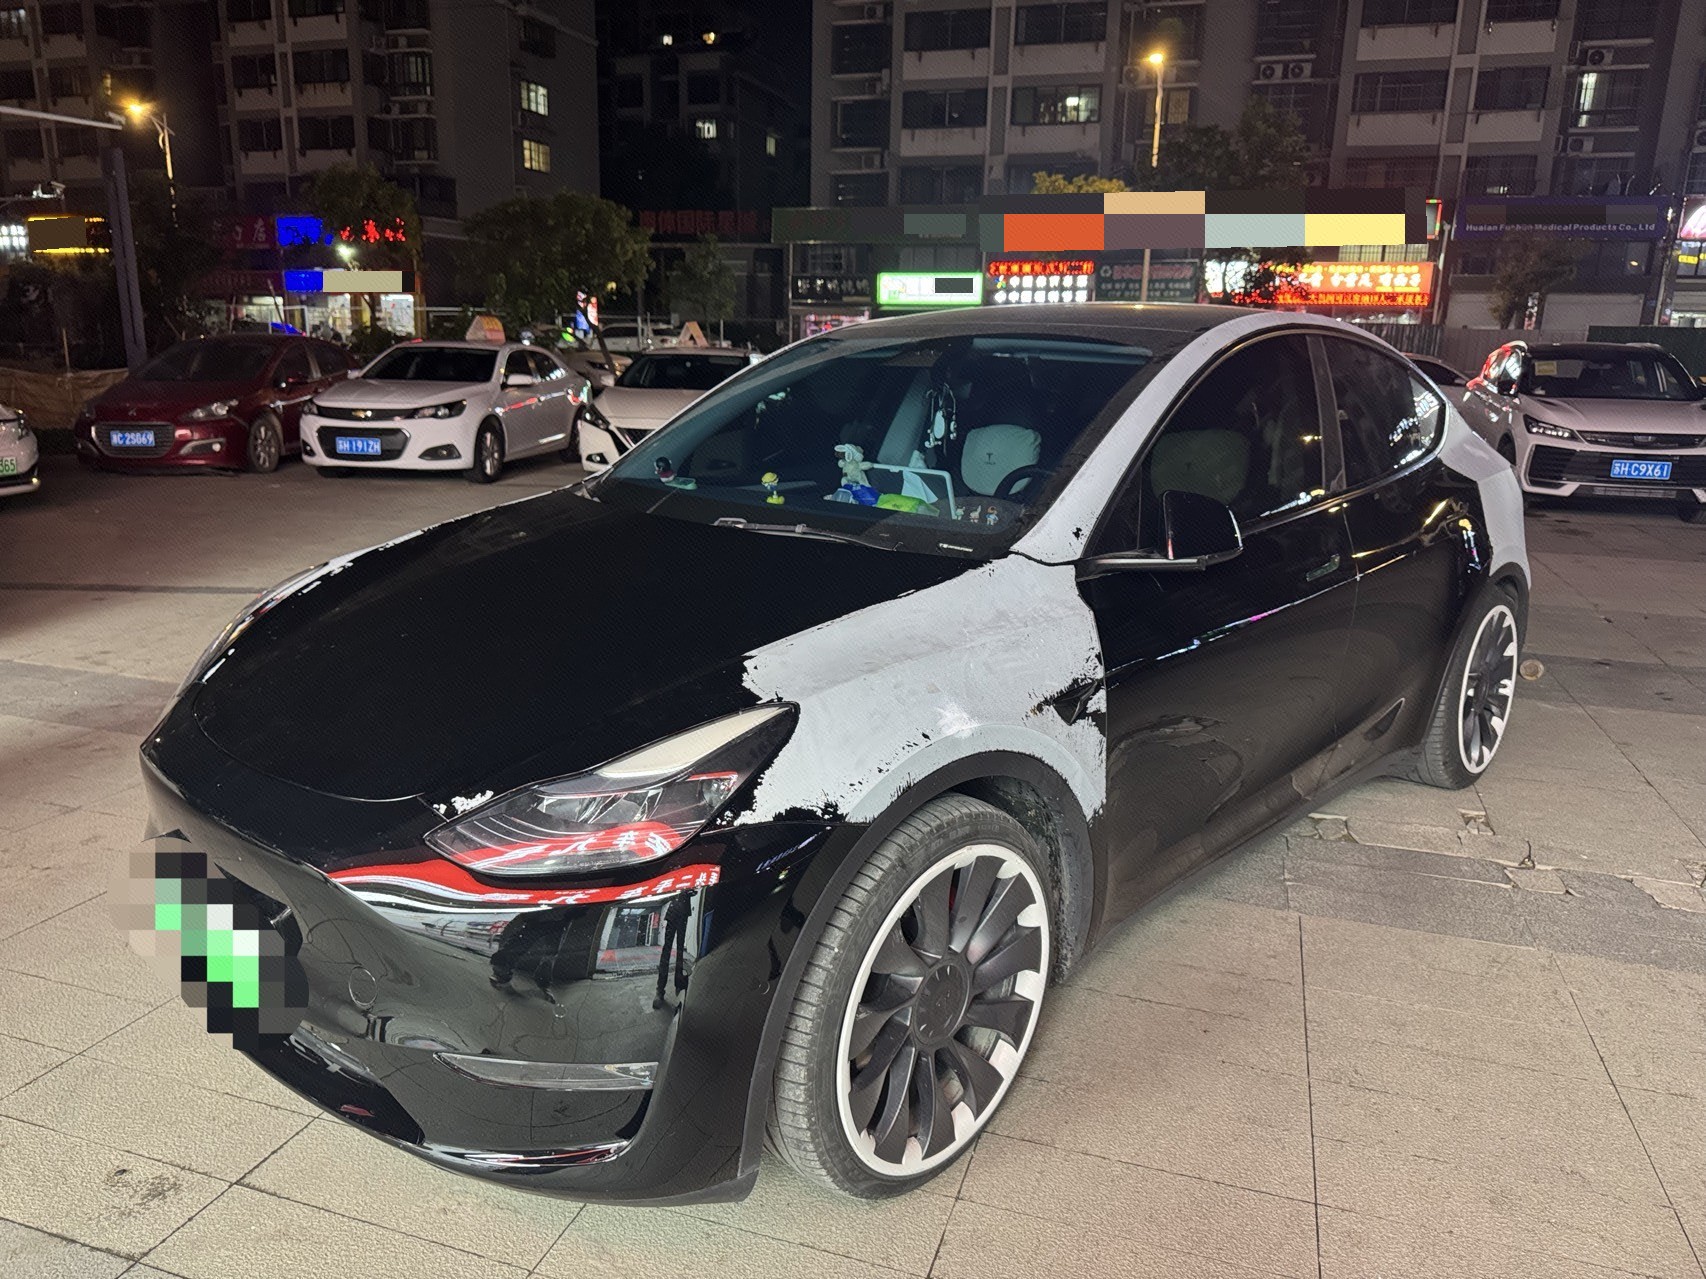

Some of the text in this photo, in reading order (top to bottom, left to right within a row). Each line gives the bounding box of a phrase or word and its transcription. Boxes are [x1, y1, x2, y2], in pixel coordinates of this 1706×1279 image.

[1534, 223, 1572, 232] Medical
[1573, 223, 1617, 231] Products
[1638, 223, 1655, 231] Ltd
